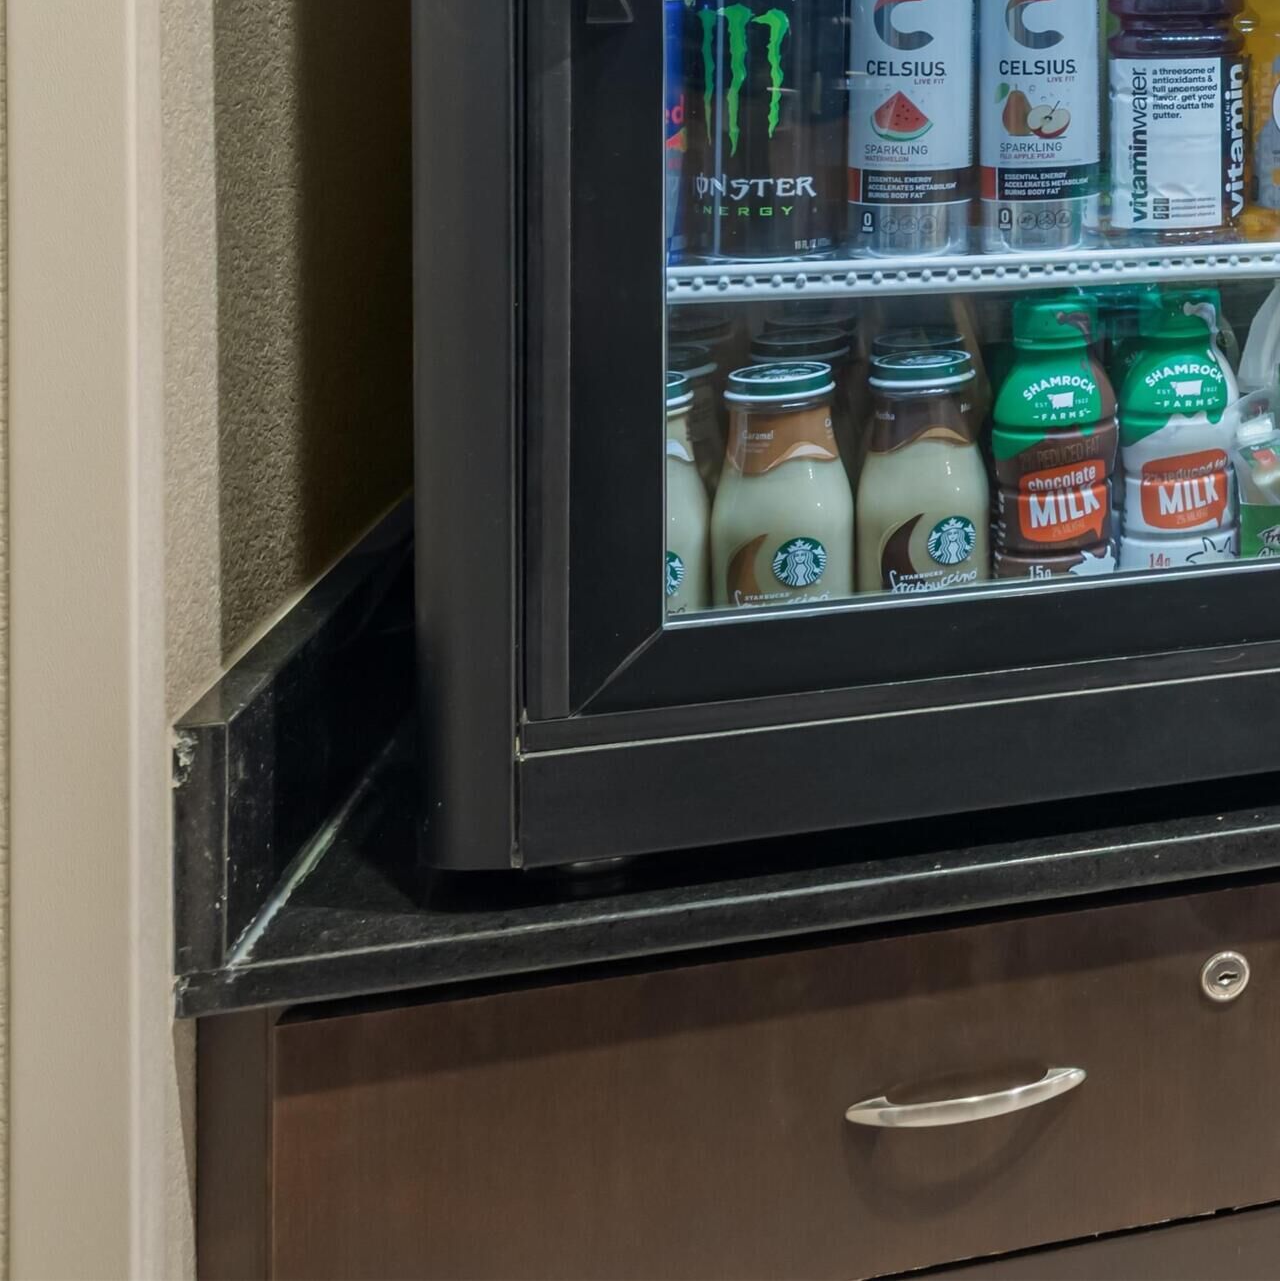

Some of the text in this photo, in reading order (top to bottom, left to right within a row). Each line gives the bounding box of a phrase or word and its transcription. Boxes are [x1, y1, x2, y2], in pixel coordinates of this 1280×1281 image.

[866, 60, 946, 77] CELSIUS
[1000, 59, 1077, 75] CELSIUS
[1159, 67, 1205, 75] threesome
[1152, 76, 1206, 84] antioxidants
[1152, 84, 1218, 93] full uncensored
[1181, 95, 1196, 103] get
[1198, 94, 1216, 102] your
[1152, 102, 1174, 110] mind
[1201, 101, 1215, 109] the
[1152, 112, 1183, 120] gutter.
[1129, 67, 1148, 222] vitaminwater
[1225, 64, 1244, 218] vitamin
[864, 144, 928, 155] SPARKLING
[1000, 142, 1063, 152] SPARKLING
[1145, 363, 1223, 387] SHAMROCK
[1023, 375, 1096, 401] SHAMROCK
[1163, 399, 1214, 408] FARMS
[1041, 410, 1085, 421] FARMS
[742, 430, 774, 440] Caramel
[1028, 465, 1096, 491] chocolate
[1158, 475, 1219, 516] MILK
[1029, 480, 1100, 529] MILK
[900, 571, 943, 580] STARBUCKS
[744, 591, 788, 601] STARBUCKS
